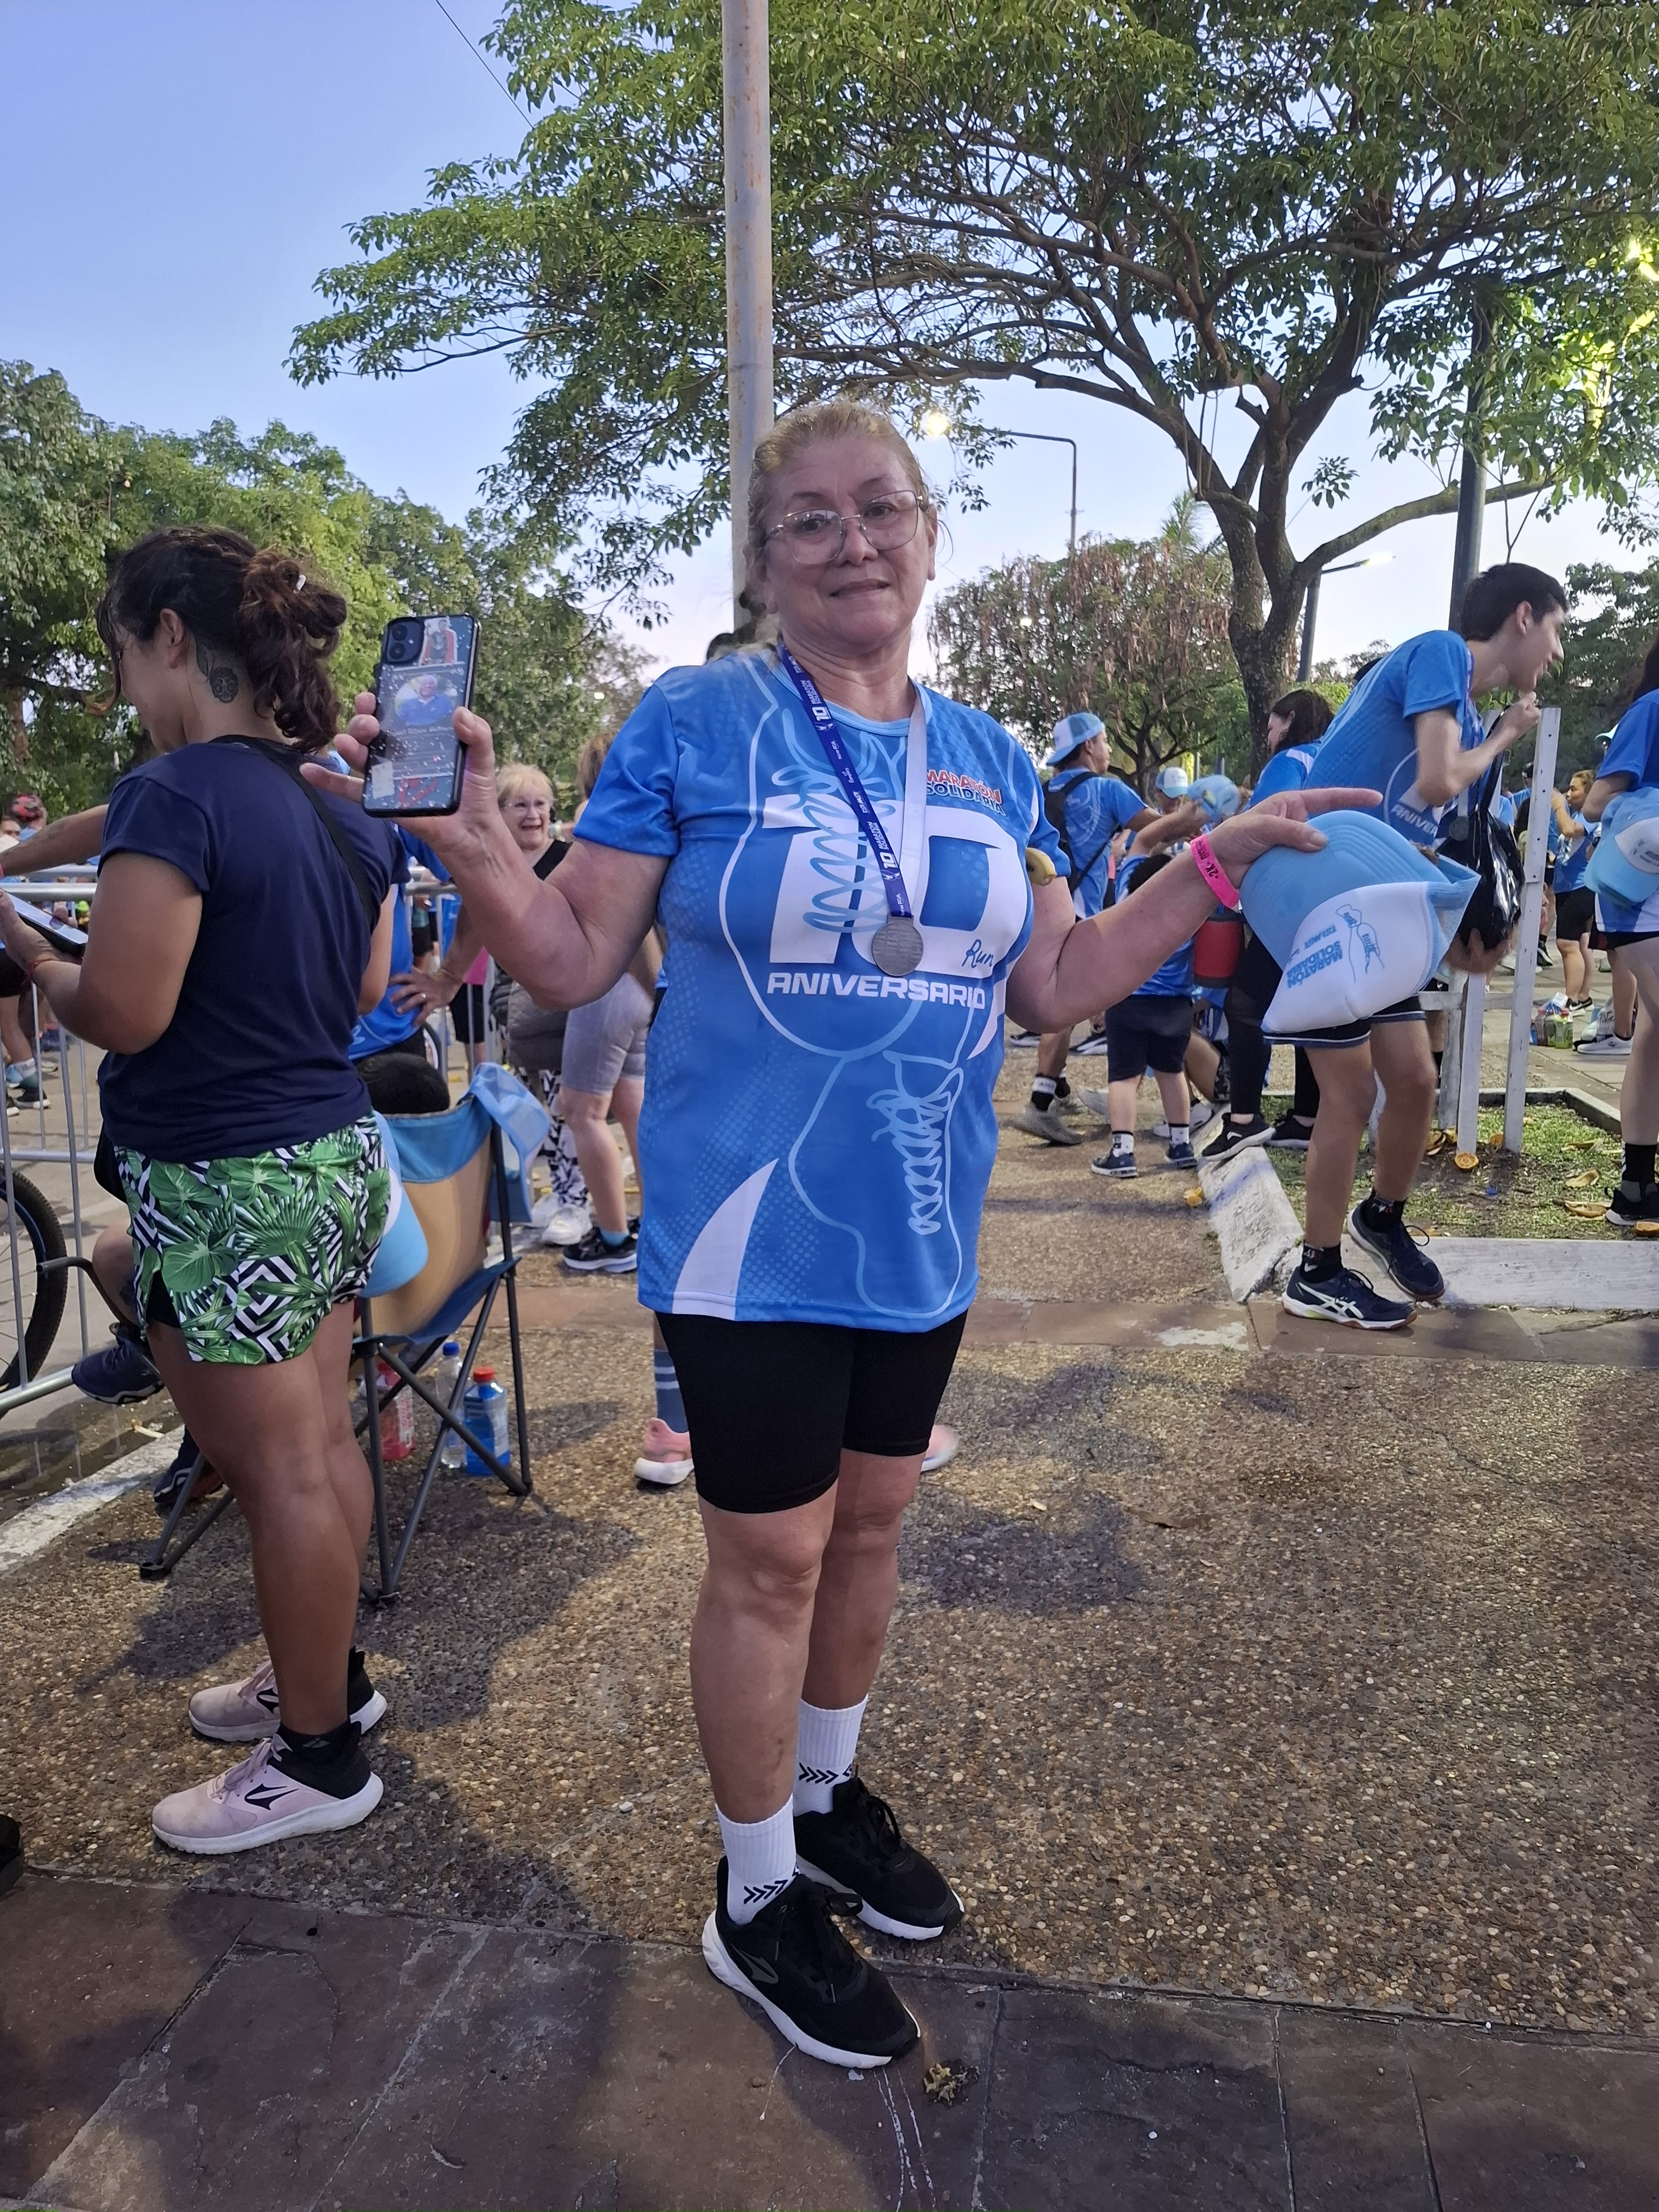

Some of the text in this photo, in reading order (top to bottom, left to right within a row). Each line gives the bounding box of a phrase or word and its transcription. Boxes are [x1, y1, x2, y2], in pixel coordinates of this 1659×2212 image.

[812, 706, 831, 721] 10
[927, 769, 1002, 804] MARATÓN
[927, 782, 1007, 816] SOLIDARIA
[1391, 803, 1438, 838] ANIVER
[879, 852, 897, 869] 10
[1205, 863, 1219, 877] 2K
[962, 939, 994, 968] Run
[1287, 941, 1340, 978] SOLIDARIA
[1287, 950, 1343, 988] MARATÓN
[767, 972, 986, 1010] ANIVERSARIO
